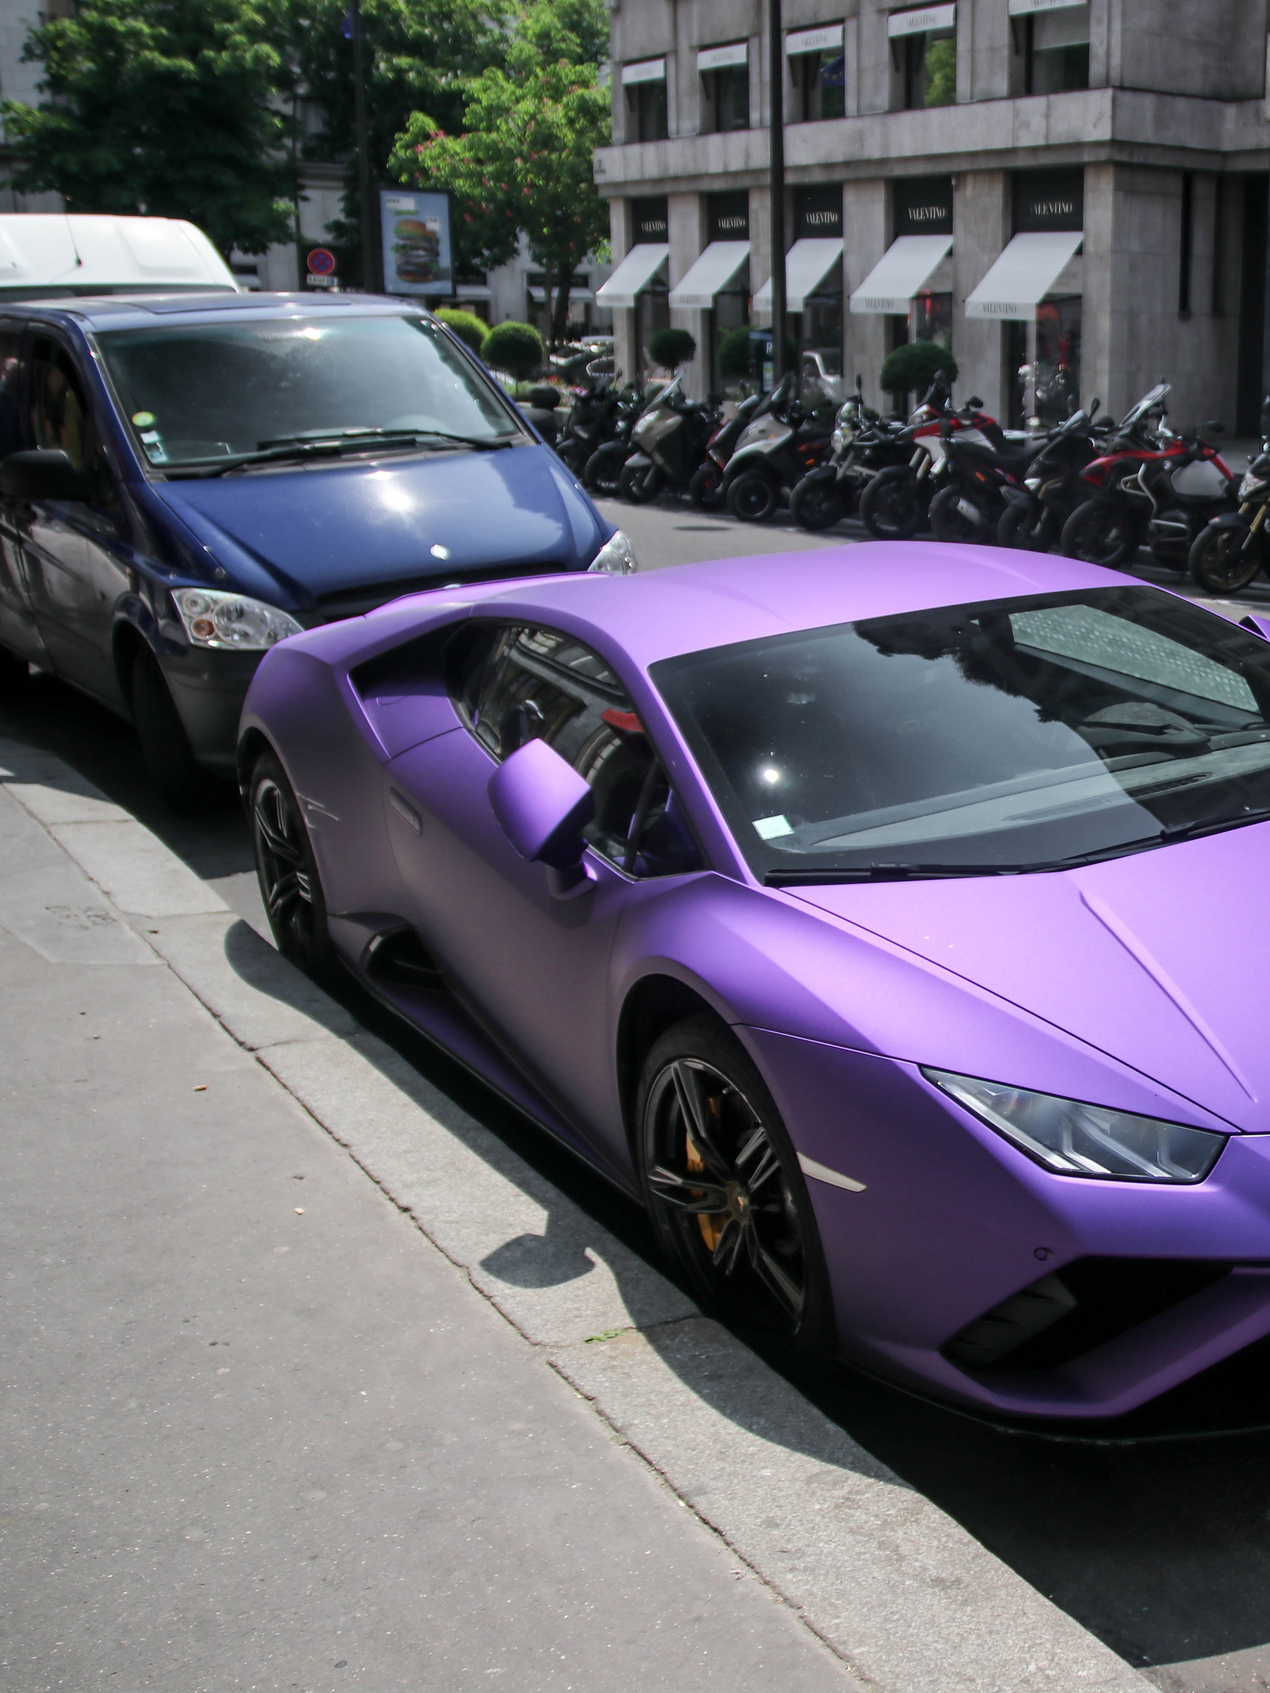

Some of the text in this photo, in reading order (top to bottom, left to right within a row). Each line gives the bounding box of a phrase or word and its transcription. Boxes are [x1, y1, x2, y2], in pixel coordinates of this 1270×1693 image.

[908, 206, 947, 221] VALENTINO
[1029, 202, 1073, 216] VALENTINO
[717, 217, 746, 230] VALENTINO
[806, 211, 838, 225] VALENTINO
[641, 220, 666, 233] VALENTINO
[865, 298, 894, 309] VALENTINO
[982, 303, 1017, 315] VALENTINO
